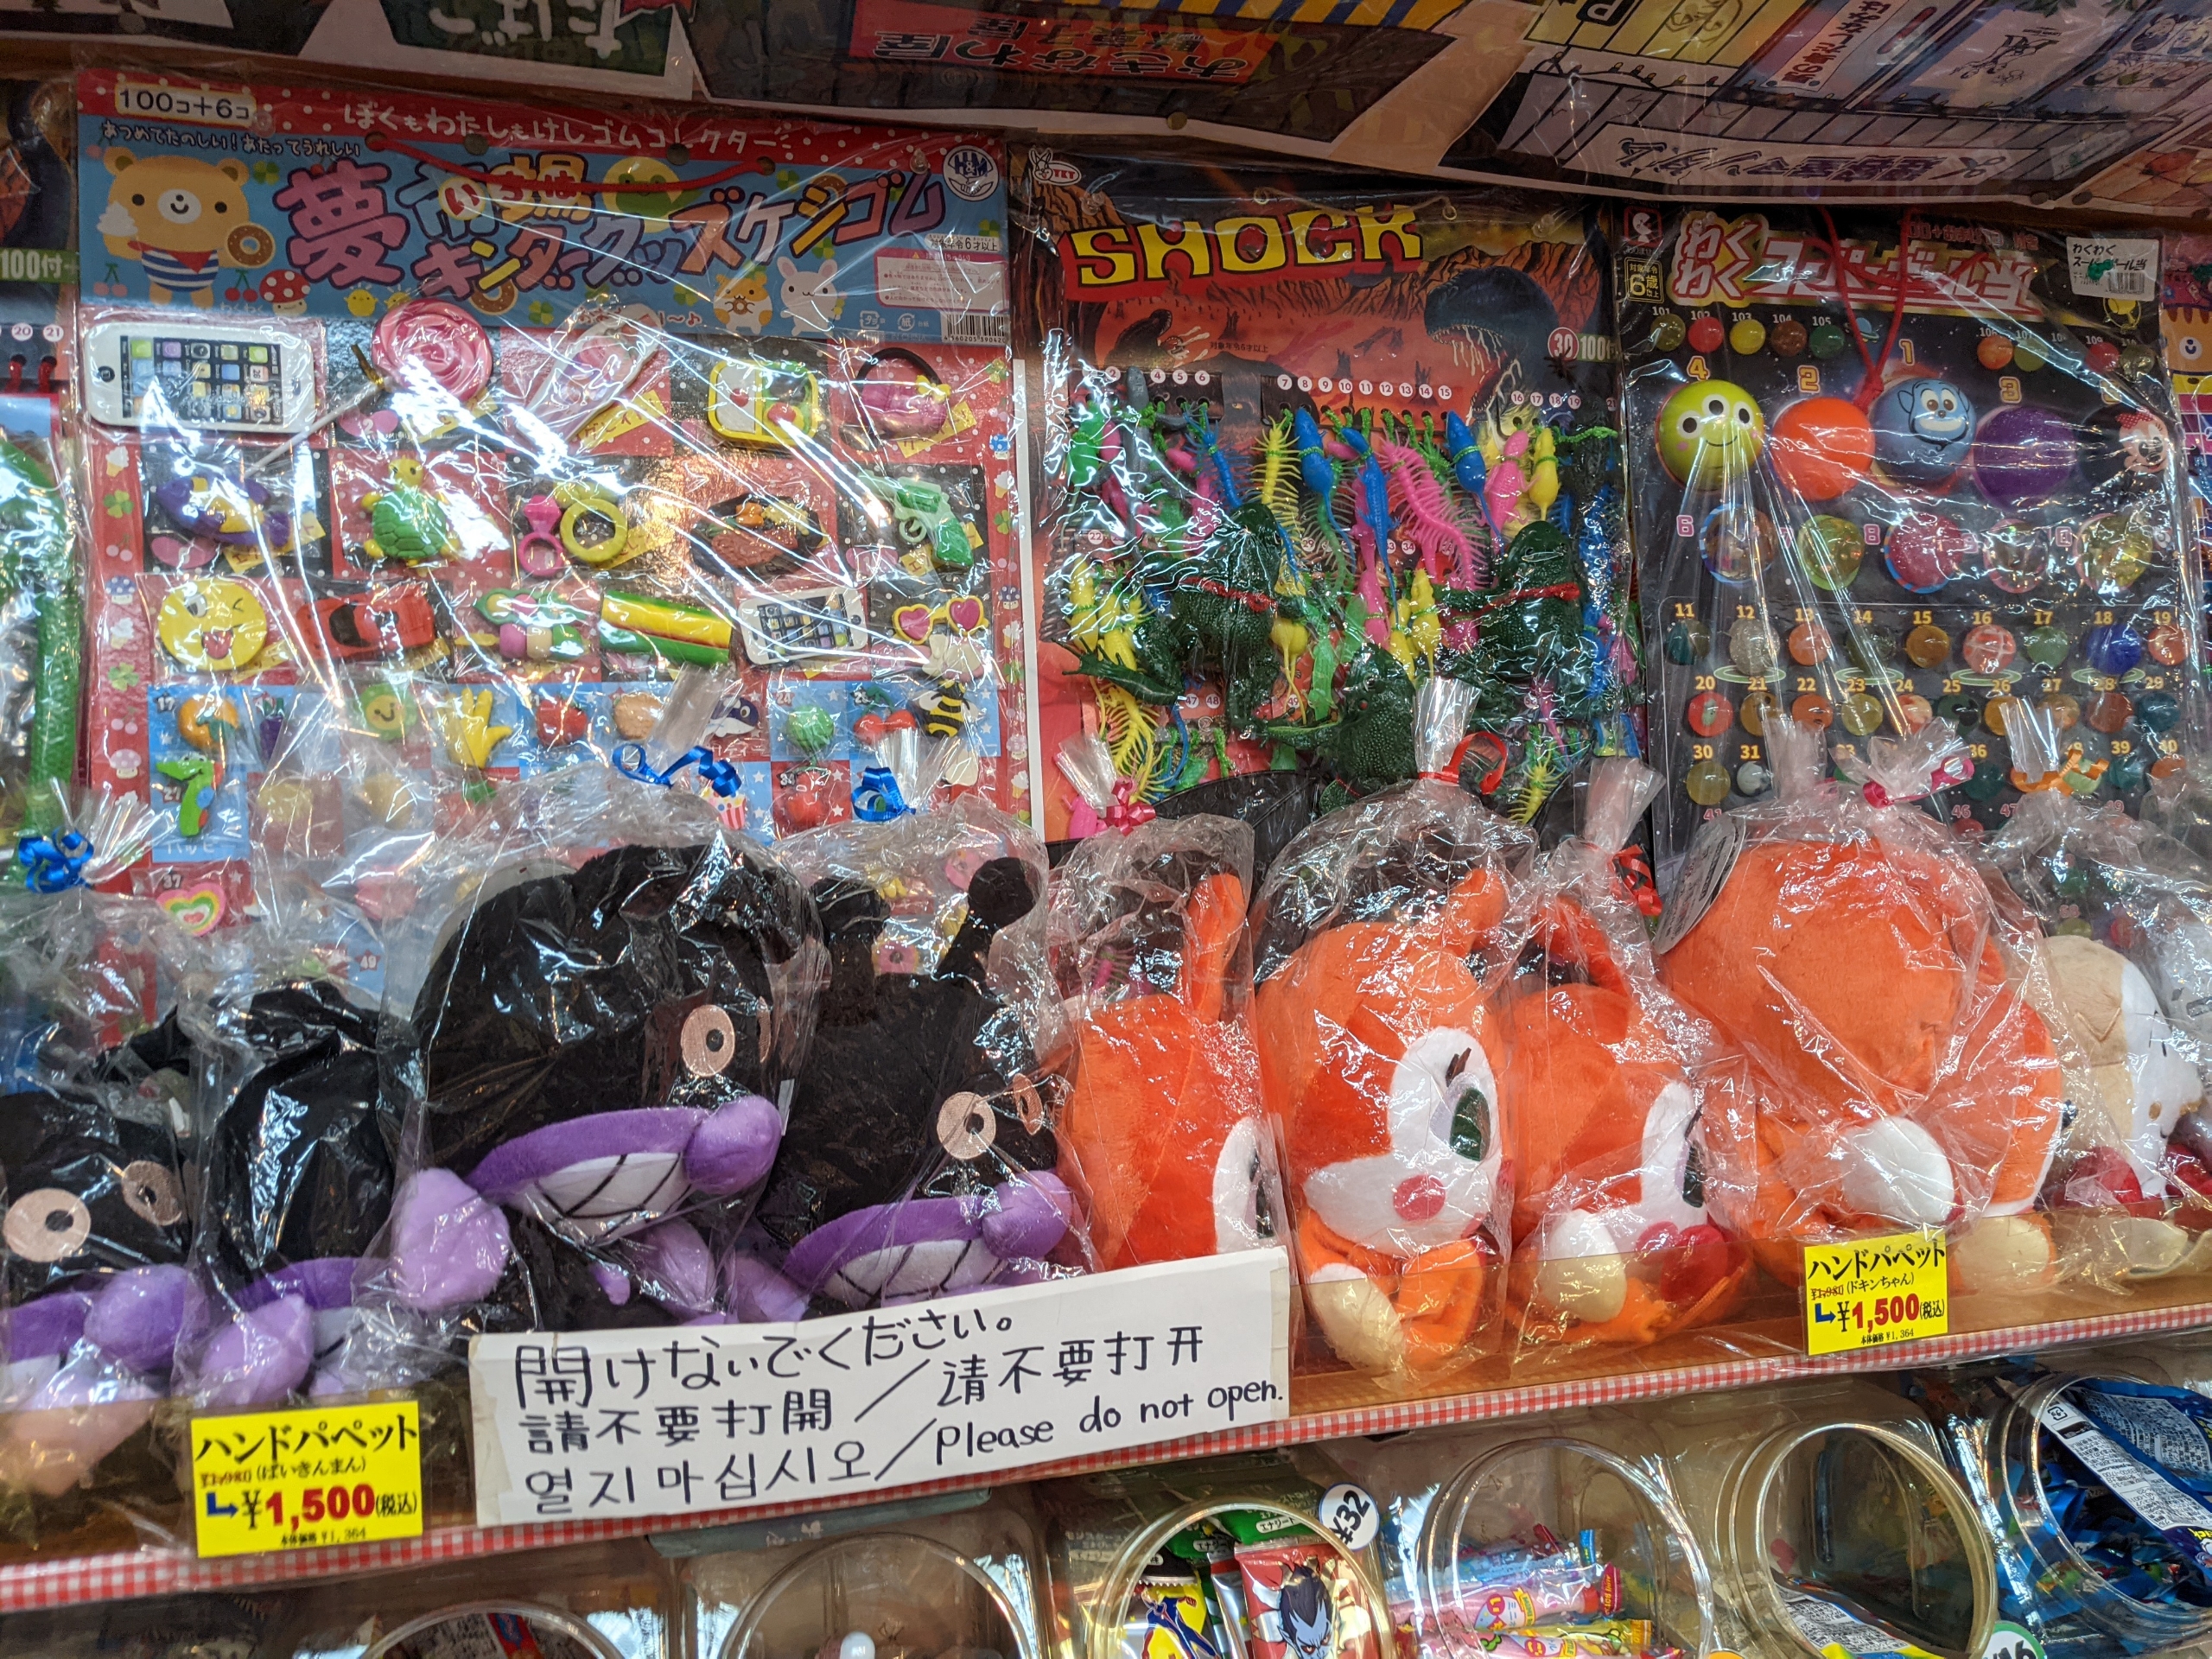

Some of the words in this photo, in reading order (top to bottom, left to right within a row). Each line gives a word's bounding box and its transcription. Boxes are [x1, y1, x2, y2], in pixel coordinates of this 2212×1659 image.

[872, 30, 1249, 79] おきなわ屋
[1072, 204, 1423, 288] SHOCK
[2072, 243, 2117, 257] わくわく
[14, 327, 31, 336] 20
[47, 328, 60, 338] 21
[1811, 315, 1832, 326] 105
[1554, 332, 1573, 359] 30
[1340, 382, 1351, 391] 10
[1361, 383, 1370, 392] 11
[1381, 385, 1392, 393] 12
[1401, 385, 1412, 395] 13
[1420, 387, 1431, 397] 14
[1440, 388, 1451, 397] 15
[1688, 357, 1709, 380] 4
[1798, 366, 1820, 392] 2
[2000, 377, 2021, 404] 3
[1512, 393, 1524, 403] 16
[1531, 395, 1542, 404] 17
[1550, 396, 1561, 404] 18
[1569, 397, 1580, 406] 19
[1090, 532, 1102, 543] 22
[1303, 539, 1314, 549] 29
[1402, 543, 1415, 552] 34
[1676, 515, 1694, 537] 6
[1864, 523, 1881, 545] 8
[1675, 603, 1695, 618] 11
[1735, 605, 1756, 620] 12
[1795, 607, 1815, 622] 13
[1853, 609, 1873, 624] 14
[1912, 610, 1932, 625] 15
[1973, 611, 1993, 625] 16
[2033, 611, 2054, 625] 17
[2094, 610, 2113, 625] 18
[2153, 610, 2172, 625] 19
[1694, 676, 1716, 690] 20
[1748, 677, 1768, 691] 21
[1797, 677, 1816, 691] 22
[1846, 677, 1866, 692] 23
[1895, 677, 1914, 692] 24
[1942, 679, 1961, 693] 25
[1992, 678, 2012, 692] 26
[2094, 677, 2116, 690] 28
[2144, 676, 2164, 690] 29
[1185, 696, 1198, 705] 47
[1207, 696, 1219, 706] 48
[1287, 696, 1300, 706] 49
[1693, 744, 1713, 760] 30
[1739, 745, 1760, 760] 31
[2110, 741, 2131, 755] 39
[1951, 804, 1972, 818] 46
[162, 874, 181, 889] 37
[1807, 1237, 1946, 1281] ハンドパペット
[1847, 1271, 1916, 1295] (ドキンちゃん)
[1837, 1293, 1920, 1334] ¥1,500
[517, 1307, 1013, 1409] 開けないでください。
[1079, 1394, 1124, 1433] do
[1139, 1390, 1197, 1424] not
[194, 1414, 418, 1465] ハンドパペット
[242, 1483, 376, 1531] ¥1,500
[1335, 1489, 1371, 1546] ¥32
